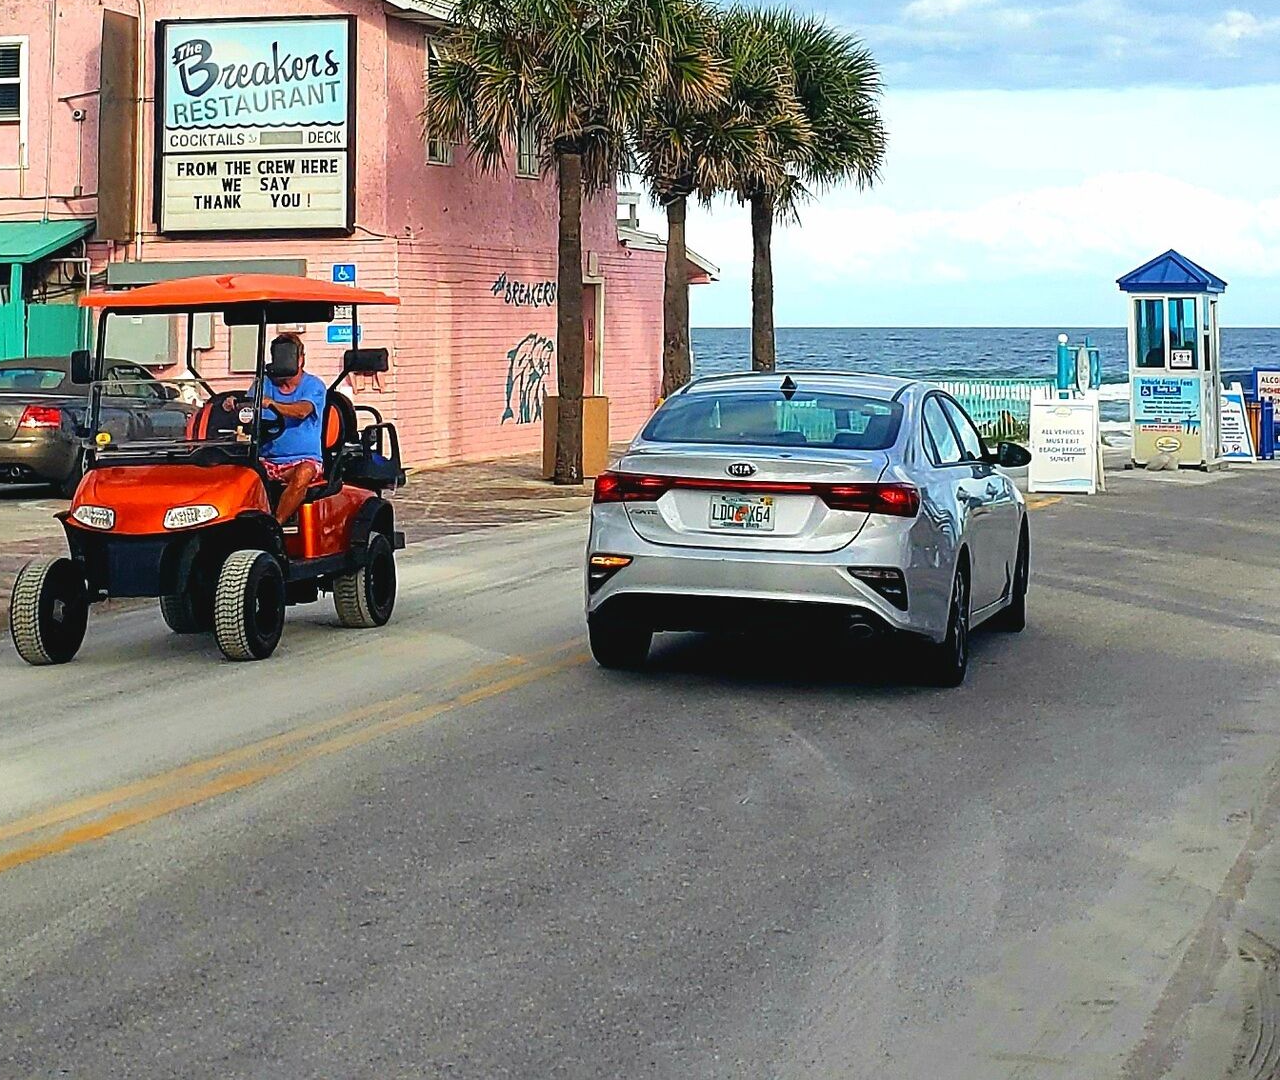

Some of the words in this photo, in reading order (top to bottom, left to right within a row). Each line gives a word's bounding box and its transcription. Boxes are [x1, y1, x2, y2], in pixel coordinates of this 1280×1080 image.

[176, 41, 203, 60] The
[172, 39, 340, 97] Breakers
[173, 80, 341, 125] RESTAURANT
[170, 132, 245, 148] COCKTAILS
[308, 130, 342, 145] DECK
[177, 162, 217, 176] FROM
[225, 161, 251, 175] THE
[257, 160, 295, 175] CREW
[301, 159, 338, 174] HERE
[222, 178, 241, 192] WE
[260, 177, 290, 191] SAY
[194, 195, 241, 210] THANK
[505, 281, 557, 308] BREAKERS
[731, 464, 751, 474] KIA
